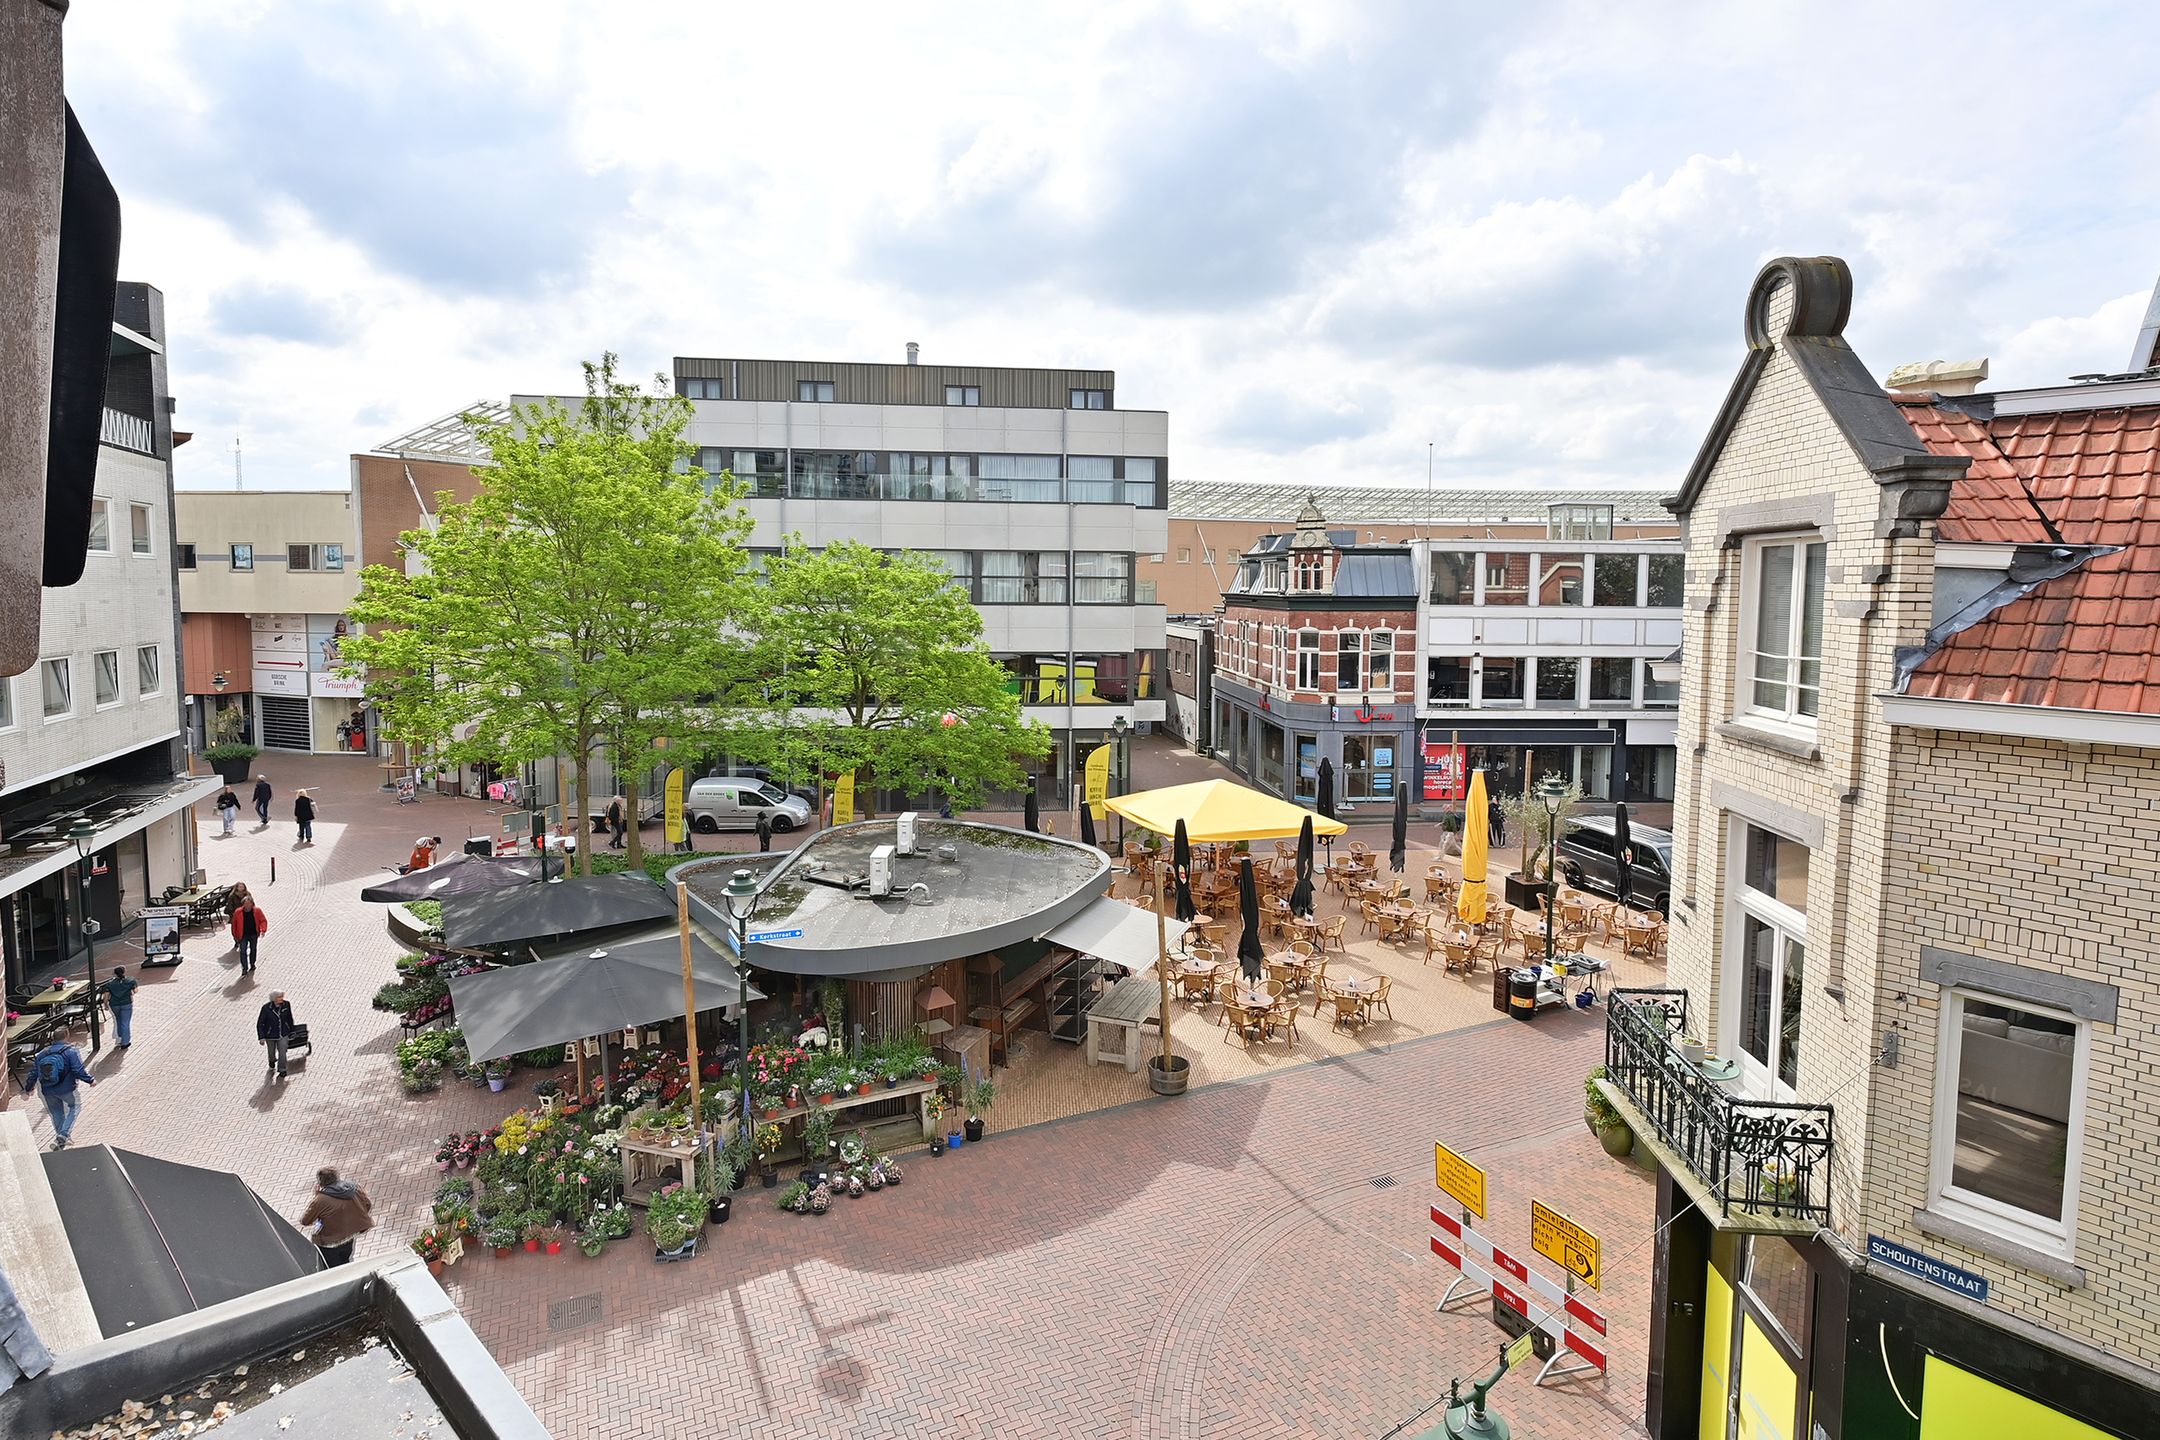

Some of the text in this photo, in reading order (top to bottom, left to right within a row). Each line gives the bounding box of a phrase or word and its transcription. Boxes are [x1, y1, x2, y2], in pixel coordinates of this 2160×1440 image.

[318, 676, 358, 693] Triumph
[1535, 1207, 1578, 1238] omleiding
[1534, 1228, 1553, 1243] dicht
[1534, 1238, 1549, 1250] volg
[1535, 1218, 1593, 1257] Plein Kerkbrink
[1872, 1242, 1981, 1293] SCHOUTENSTRAAT
